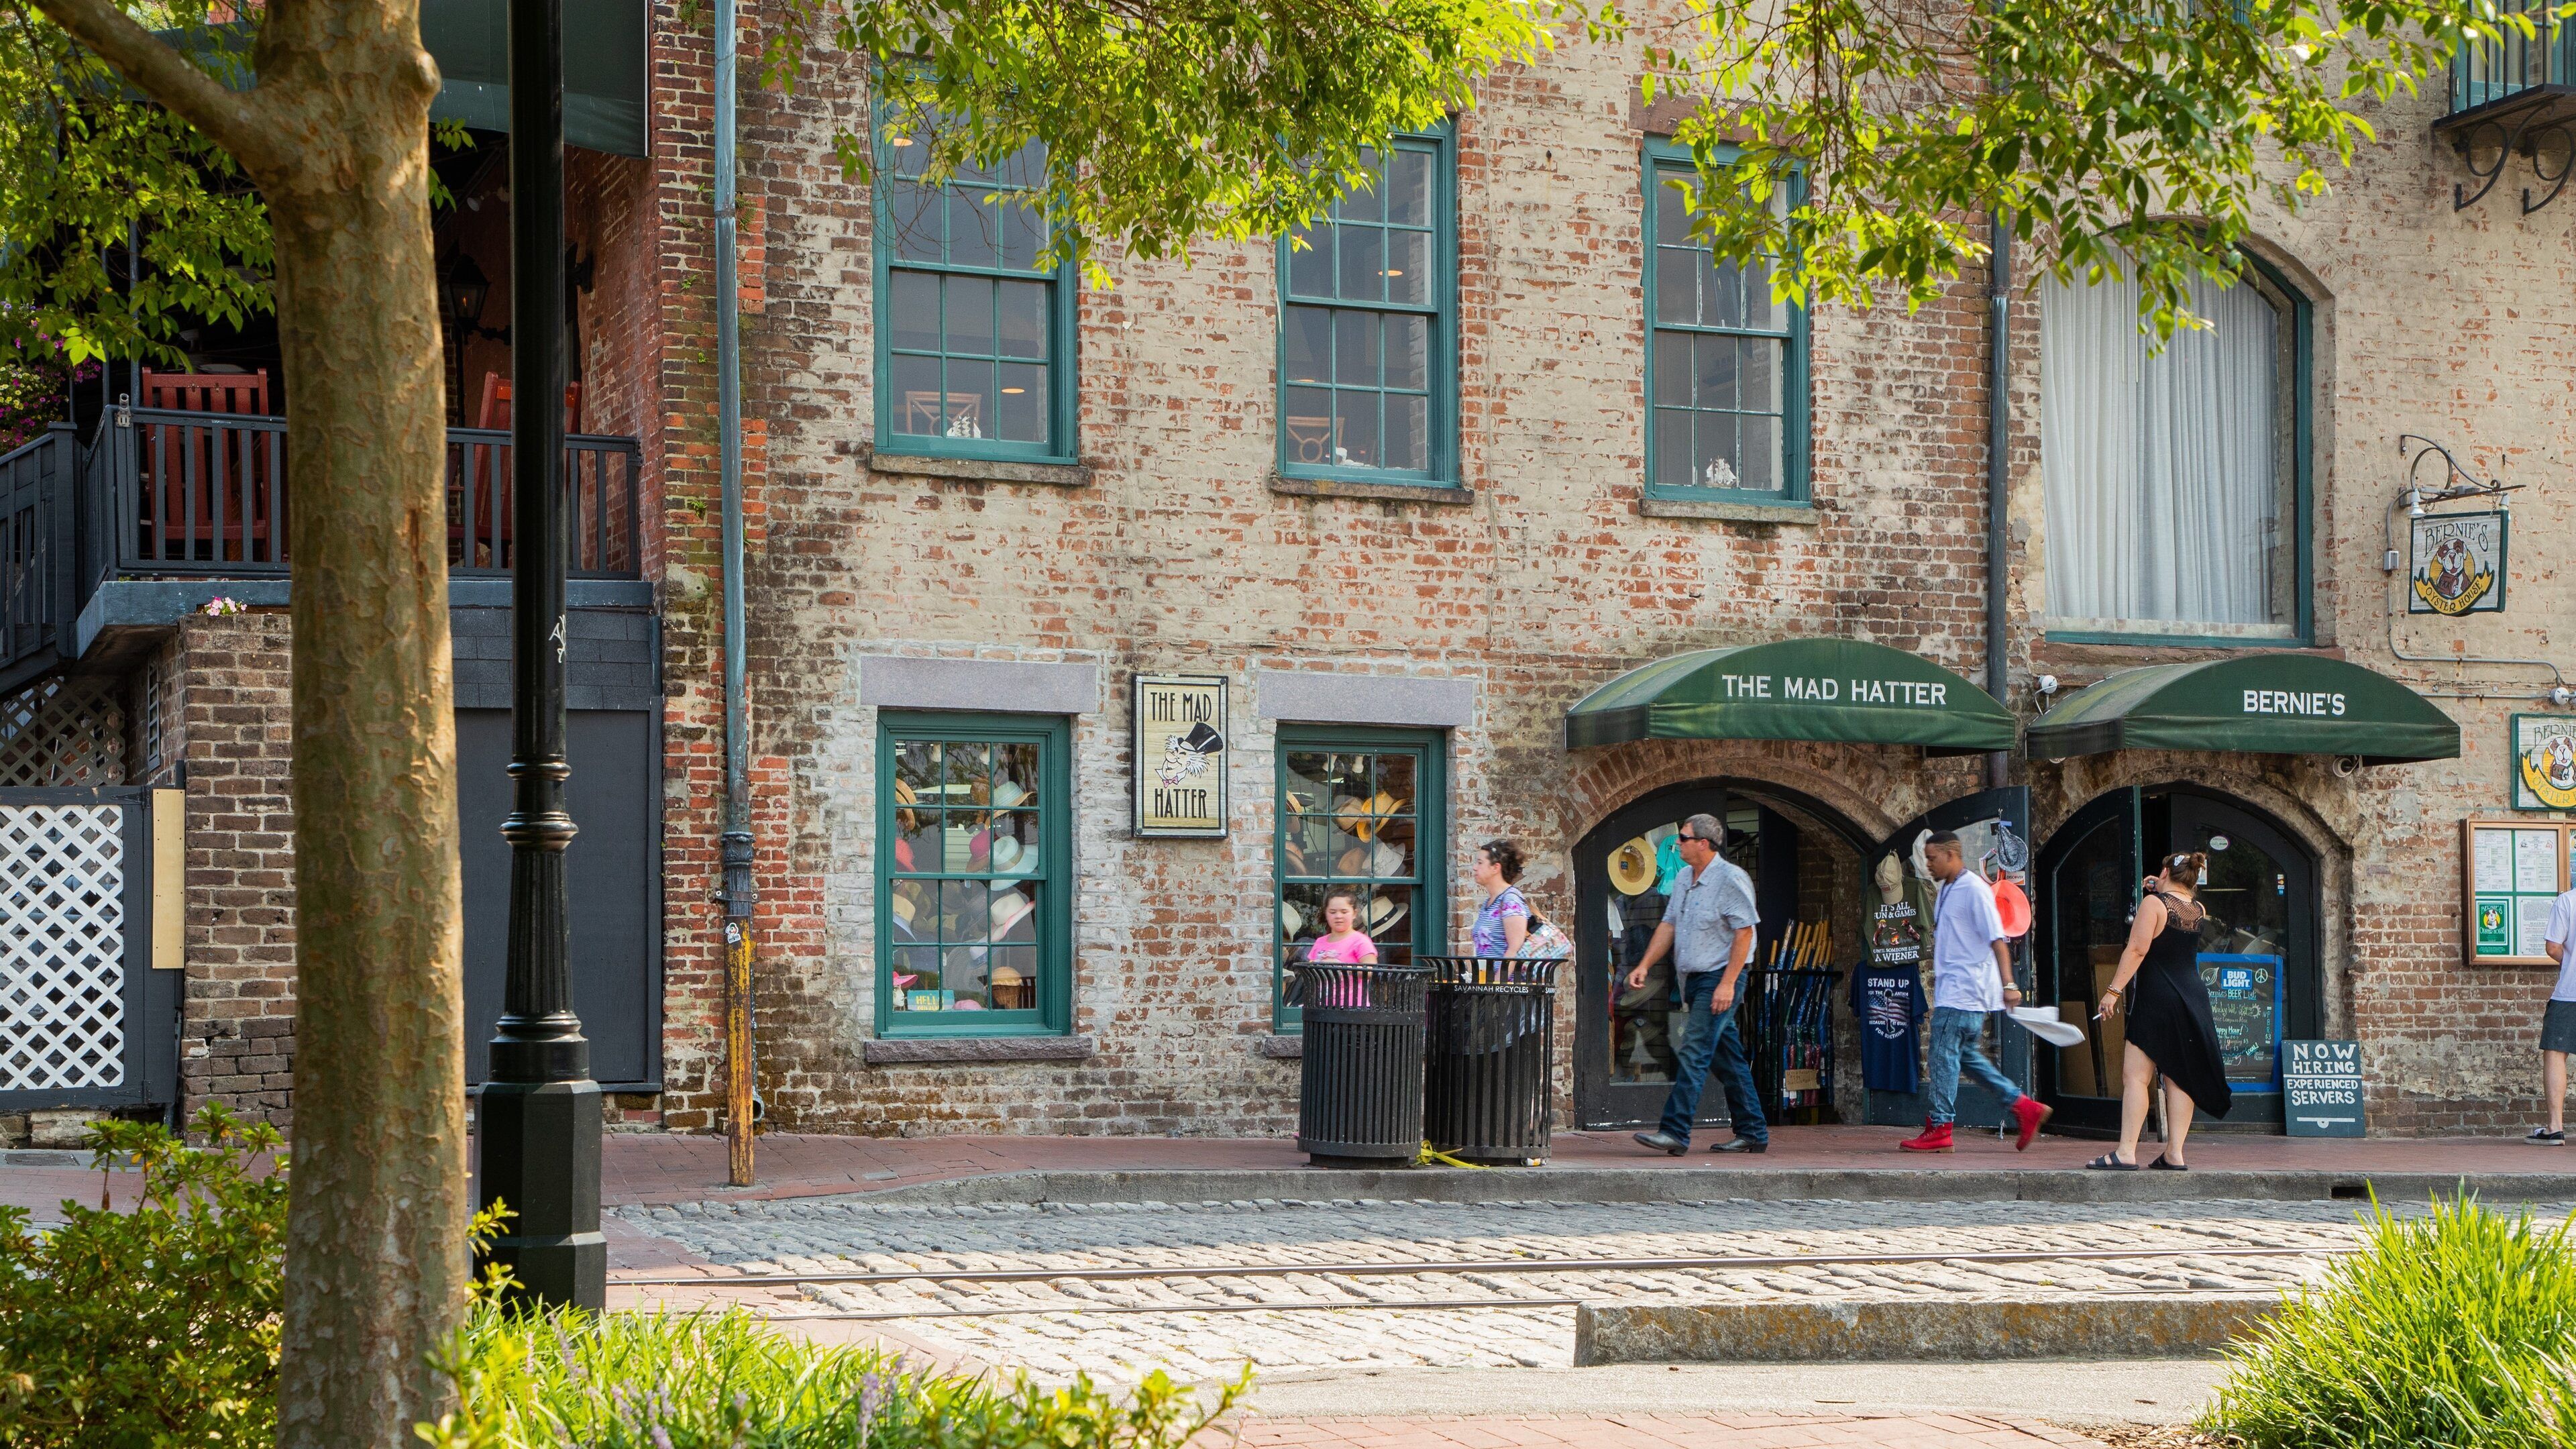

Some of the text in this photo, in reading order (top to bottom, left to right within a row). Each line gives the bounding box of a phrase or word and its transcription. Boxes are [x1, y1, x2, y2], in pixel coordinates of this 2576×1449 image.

[2424, 523, 2489, 557] BERNIE'S
[2425, 580, 2483, 612] OYSTER HOUSE
[1722, 674, 1946, 704] THE MAD HATTER
[1150, 692, 1212, 722] THE MAD
[2243, 690, 2345, 716] BERNIE'S
[2532, 776, 2570, 804] OYSTER
[1155, 788, 1207, 818] HATTER
[1880, 902, 1910, 912] IT'S ALL
[1874, 912, 1888, 920] FUN
[1894, 909, 1917, 917] GAMES
[1882, 951, 1919, 961] WIENER
[2227, 971, 2247, 979] BUD
[1868, 978, 1909, 988] STAND UP
[2223, 979, 2250, 987] LIGHT
[1454, 985, 1493, 993] SAVANNAH
[2228, 989, 2242, 998] BEER
[1875, 1027, 1884, 1036] FOR
[2293, 1043, 2356, 1060] NOW
[2292, 1061, 2356, 1073] HIRING
[2287, 1079, 2359, 1089] EXPERIENCED
[2292, 1090, 2355, 1106] SERVERS
